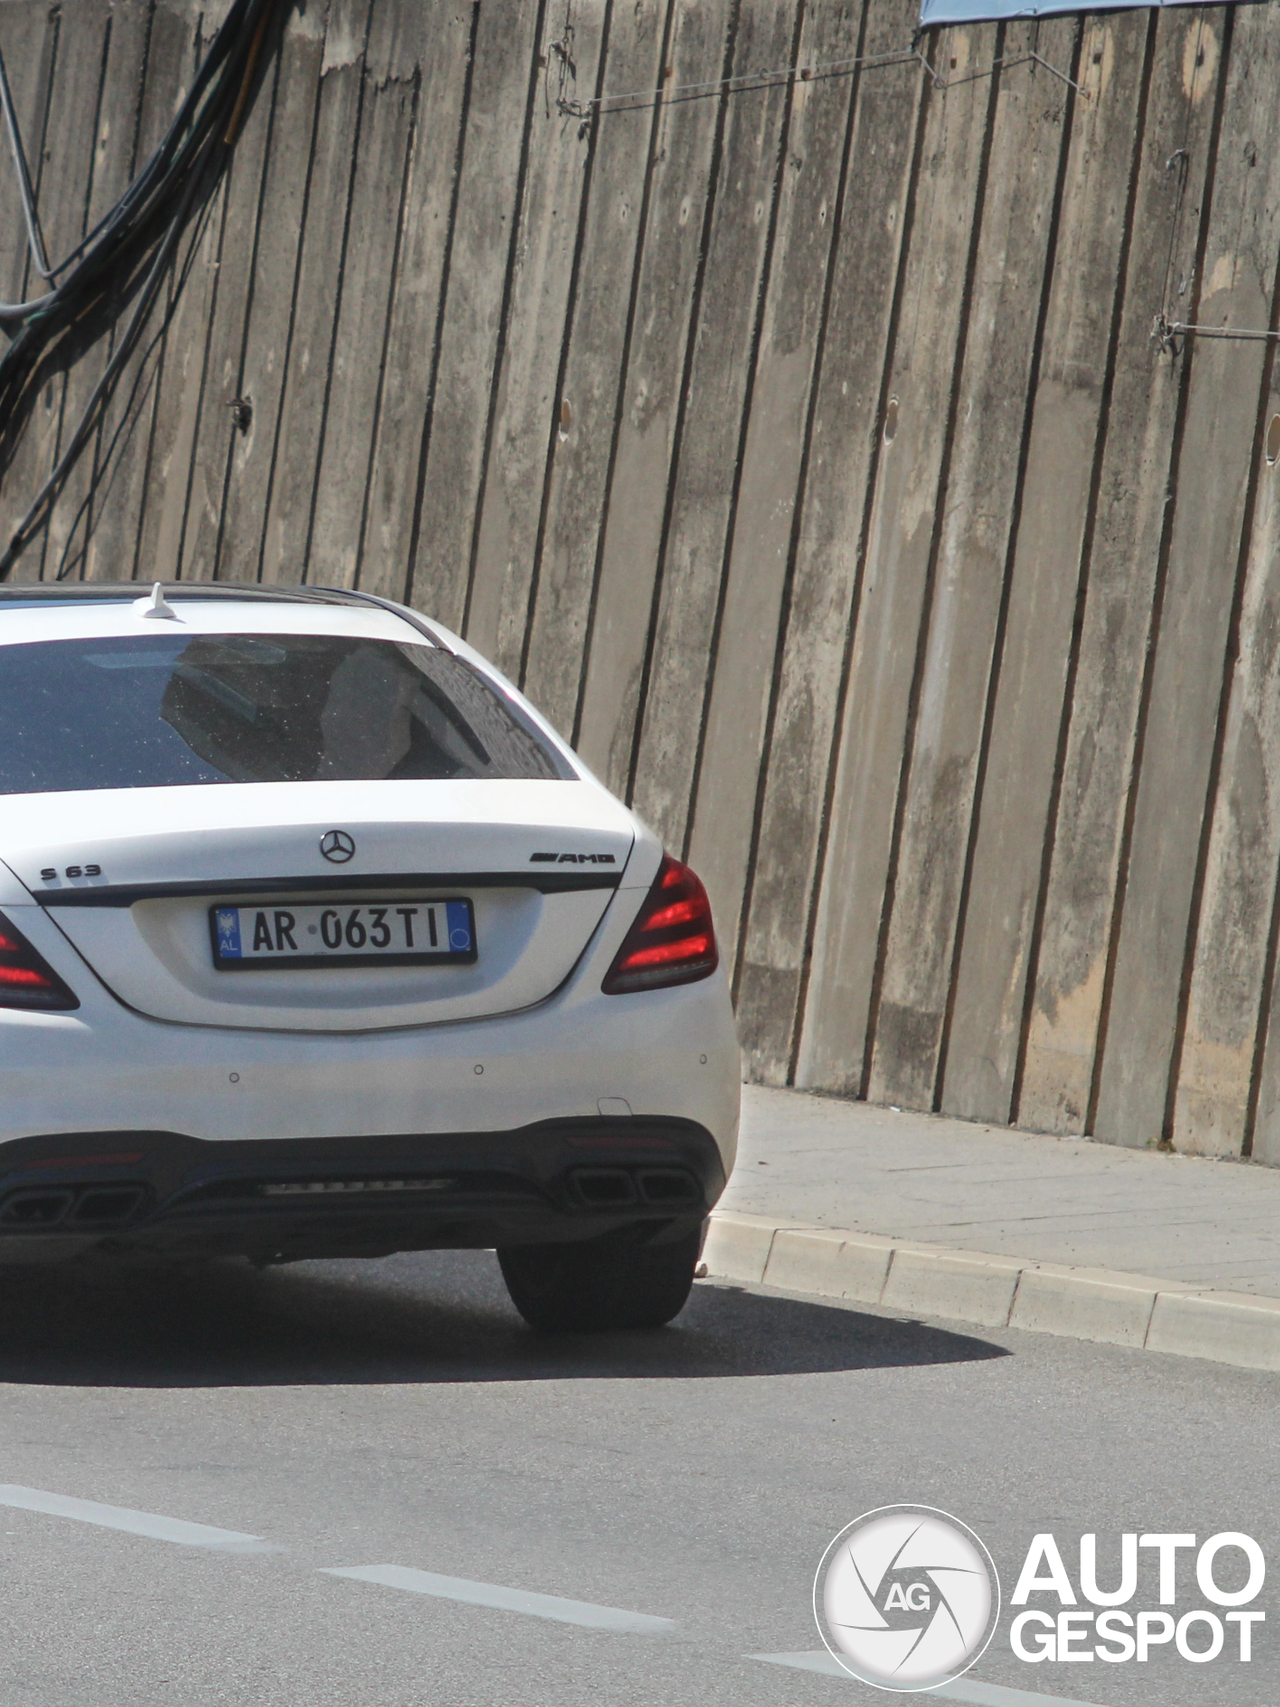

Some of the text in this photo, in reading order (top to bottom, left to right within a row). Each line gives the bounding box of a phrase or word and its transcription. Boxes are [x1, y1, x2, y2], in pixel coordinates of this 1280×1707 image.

[556, 853, 616, 864] AMG
[40, 864, 102, 881] S 63
[252, 911, 299, 951] AR
[220, 939, 239, 952] AL
